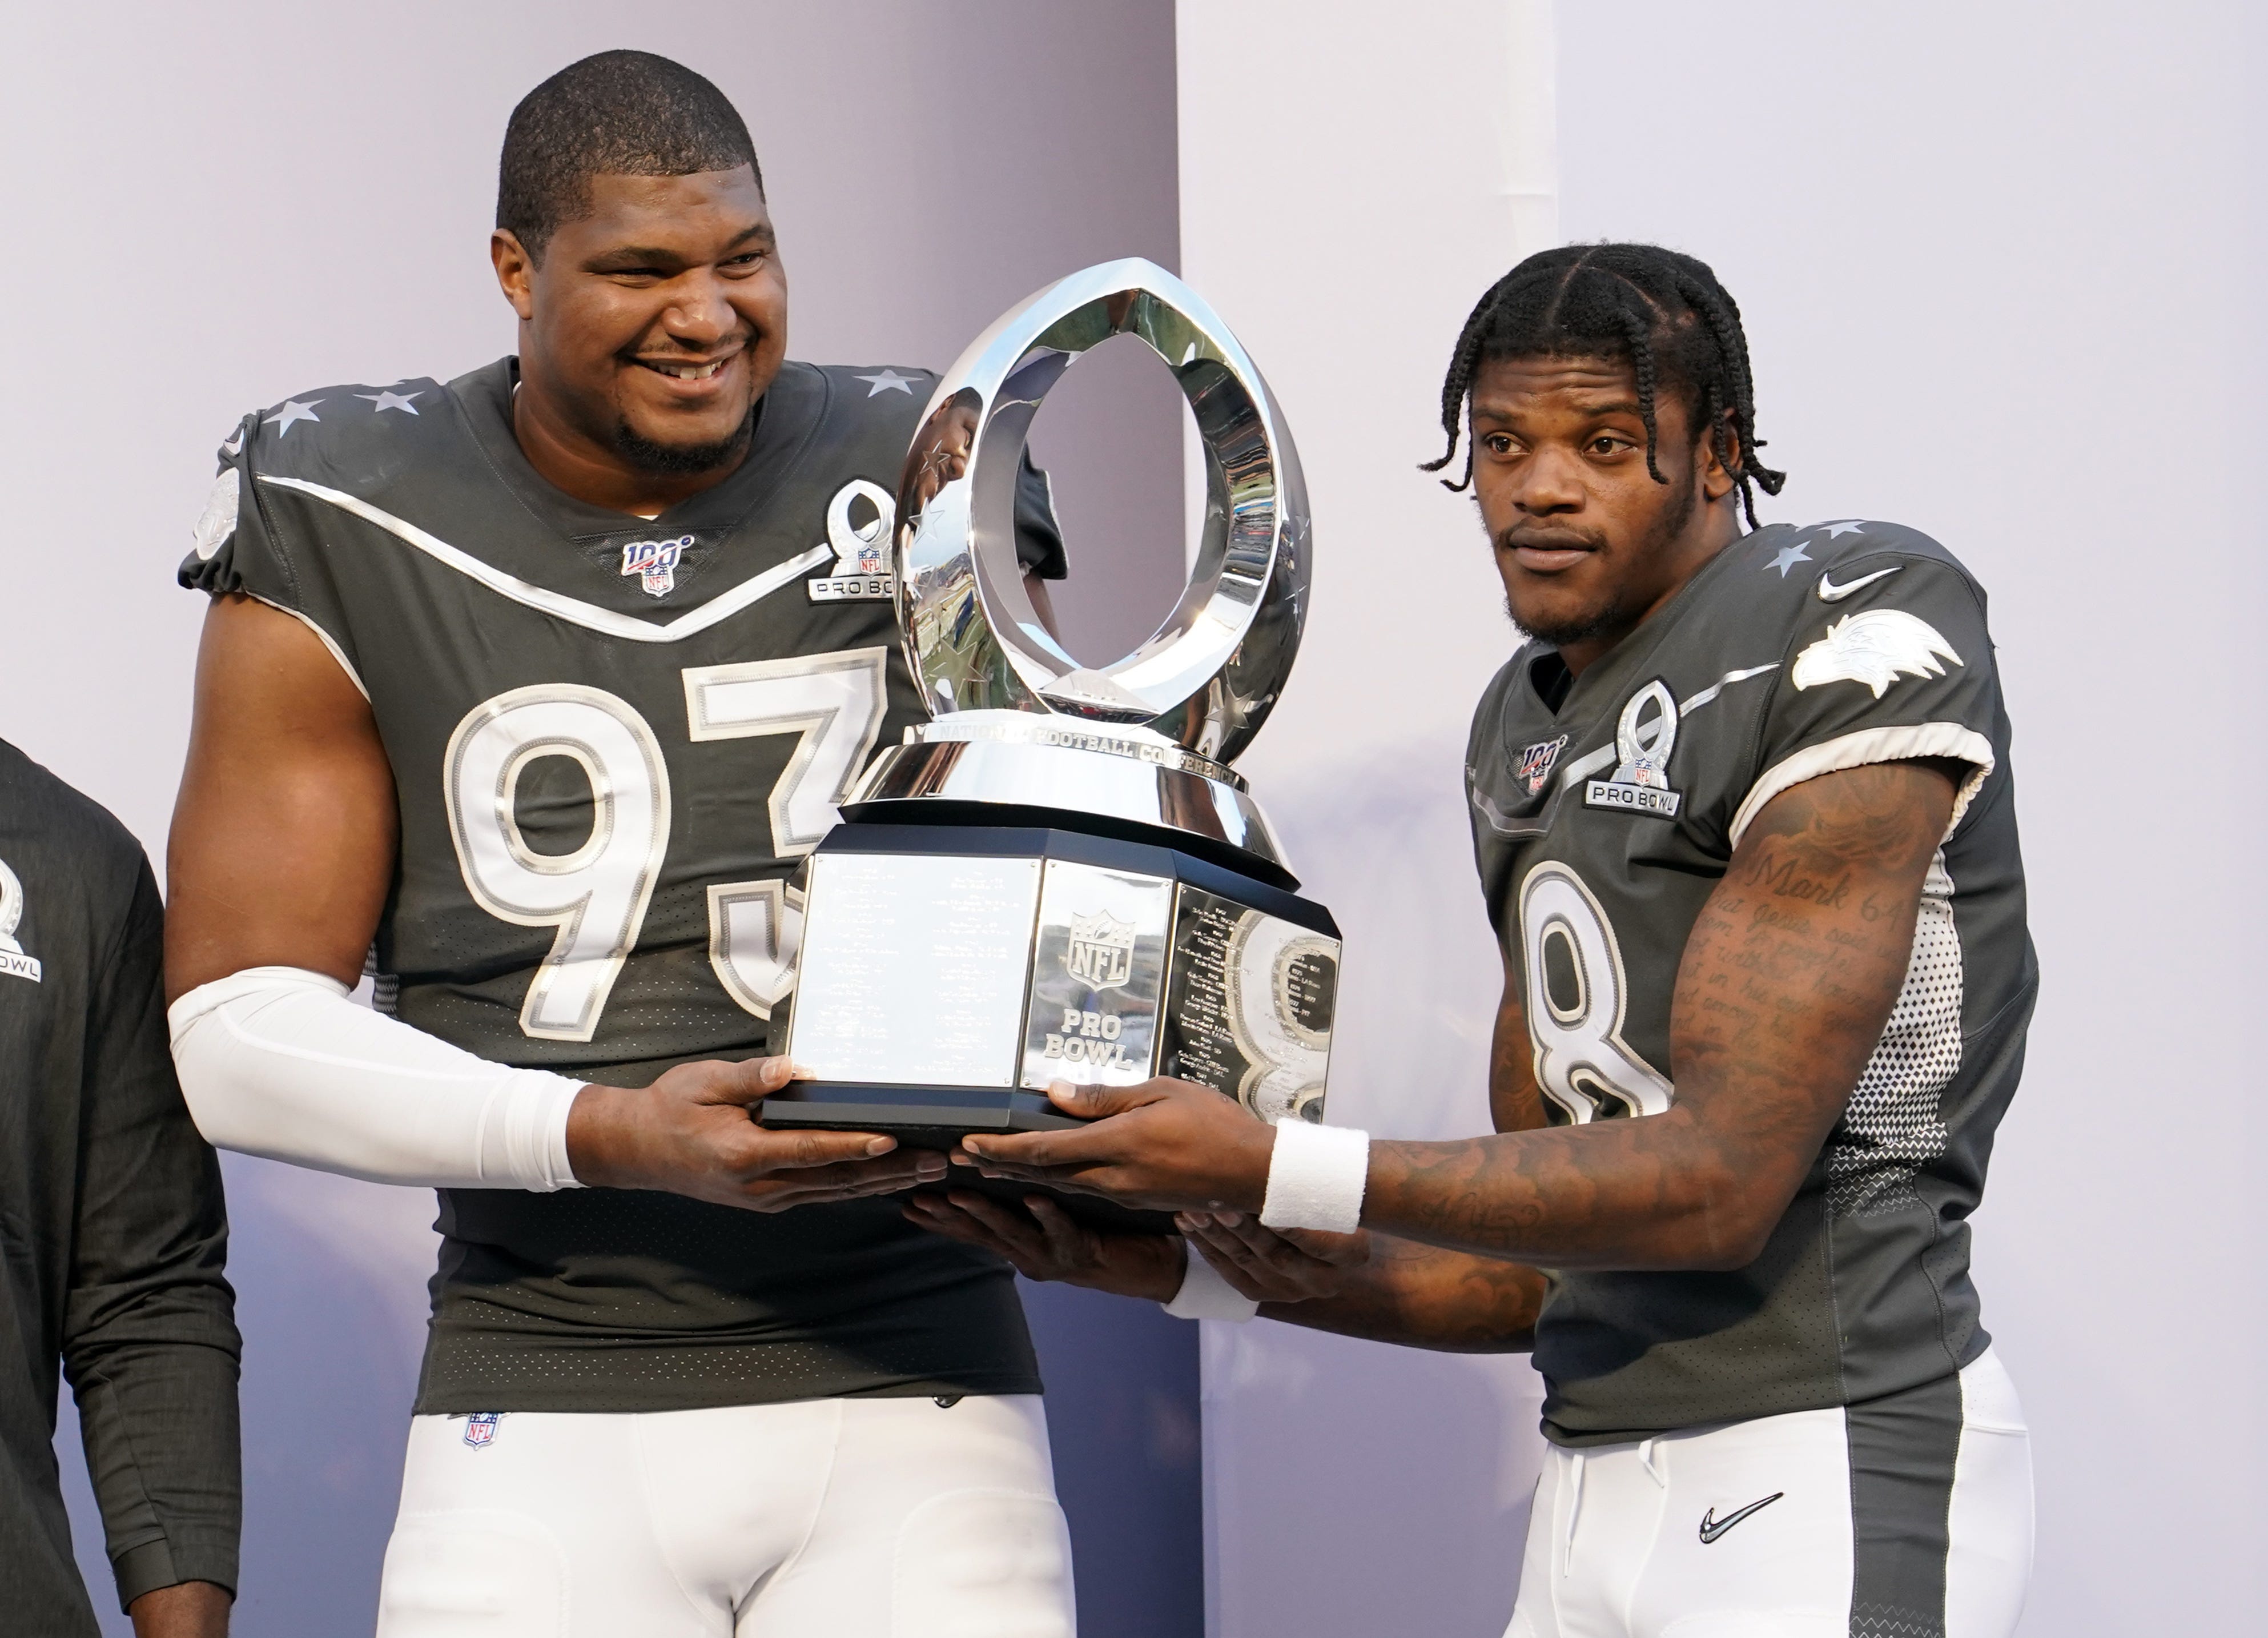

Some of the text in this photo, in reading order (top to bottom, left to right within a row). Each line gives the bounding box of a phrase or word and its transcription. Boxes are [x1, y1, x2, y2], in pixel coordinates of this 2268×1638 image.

[861, 560, 879, 572] NFL
[648, 576, 667, 589] NFL
[817, 581, 892, 596] PRO BO
[1036, 727, 1134, 757] FOOTBALL
[1635, 769, 1650, 782] NFL
[1593, 787, 1674, 811] PRO BOWL
[1745, 854, 1851, 910] Mark
[0, 956, 38, 977] OWL
[1072, 942, 1126, 983] NFL
[1519, 860, 1674, 1125] 8
[1061, 1008, 1122, 1041] PRO
[1043, 1033, 1133, 1071] BOWL
[468, 1424, 490, 1441] NFL
